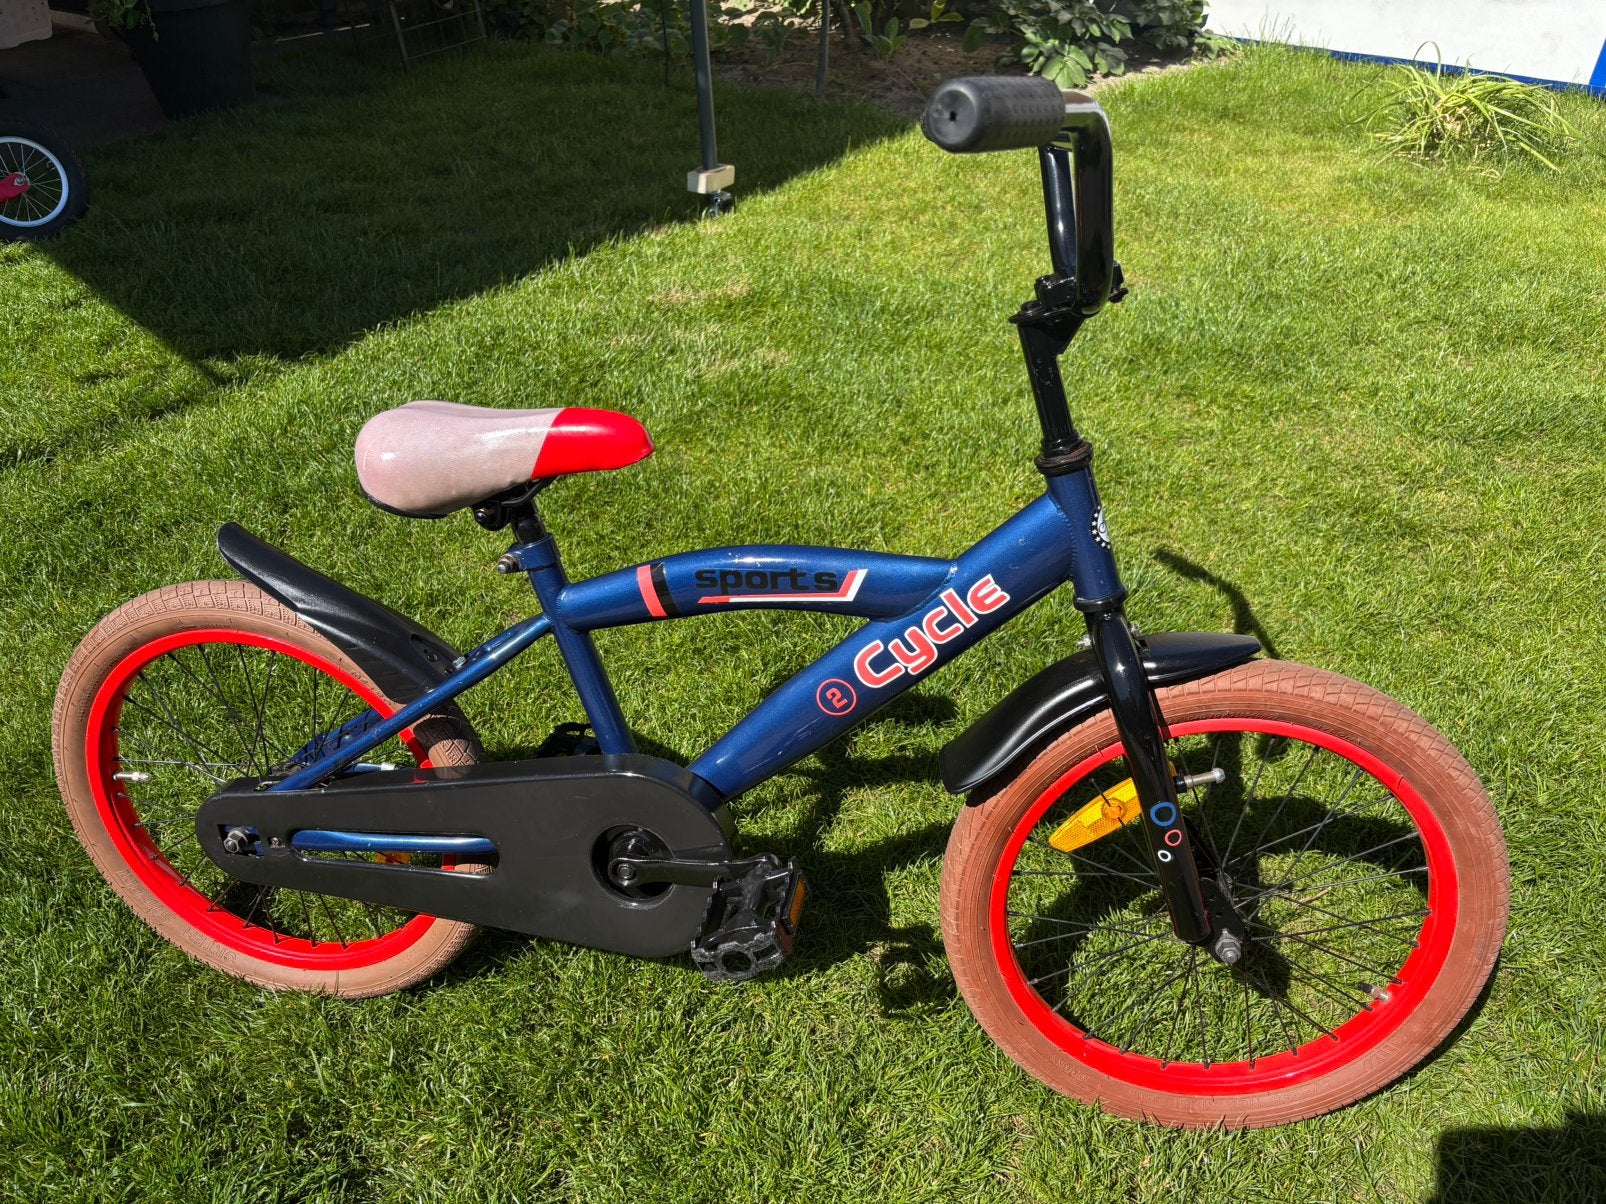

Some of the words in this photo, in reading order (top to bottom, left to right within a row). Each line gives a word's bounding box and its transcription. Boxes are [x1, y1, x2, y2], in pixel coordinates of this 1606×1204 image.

[695, 568, 838, 595] sports
[853, 574, 1010, 688] Cycle
[825, 687, 848, 709] 2
